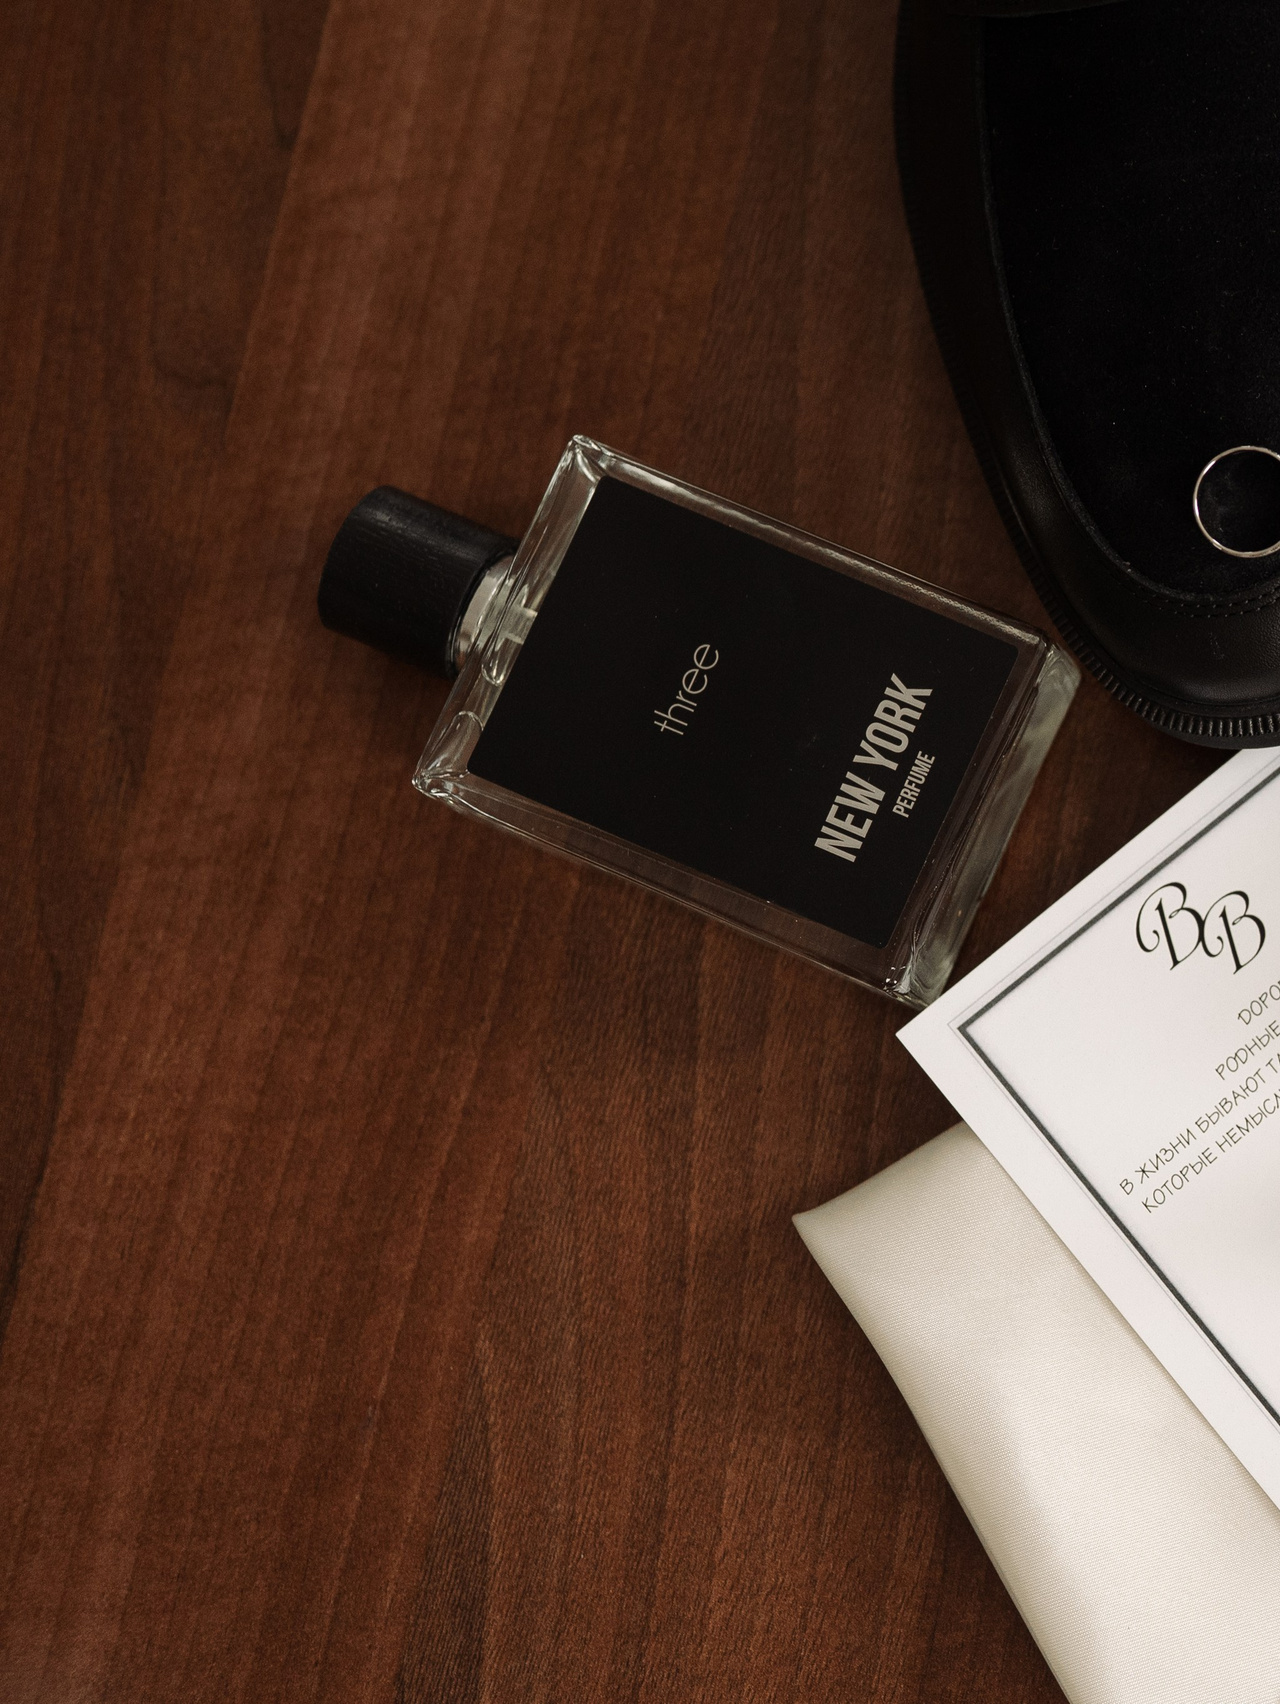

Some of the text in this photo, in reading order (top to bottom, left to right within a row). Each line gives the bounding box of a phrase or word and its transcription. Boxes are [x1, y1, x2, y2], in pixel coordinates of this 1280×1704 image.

[653, 643, 720, 736] three
[814, 672, 934, 863] NEW YORK
[892, 750, 936, 819] PERFUME
[1118, 1178, 1135, 1196] В
[1134, 1127, 1197, 1185] ЖИЗНИ
[1194, 1067, 1266, 1134] БЫВАЮТ
[1141, 1146, 1218, 1214] КОТОРЫЕ
